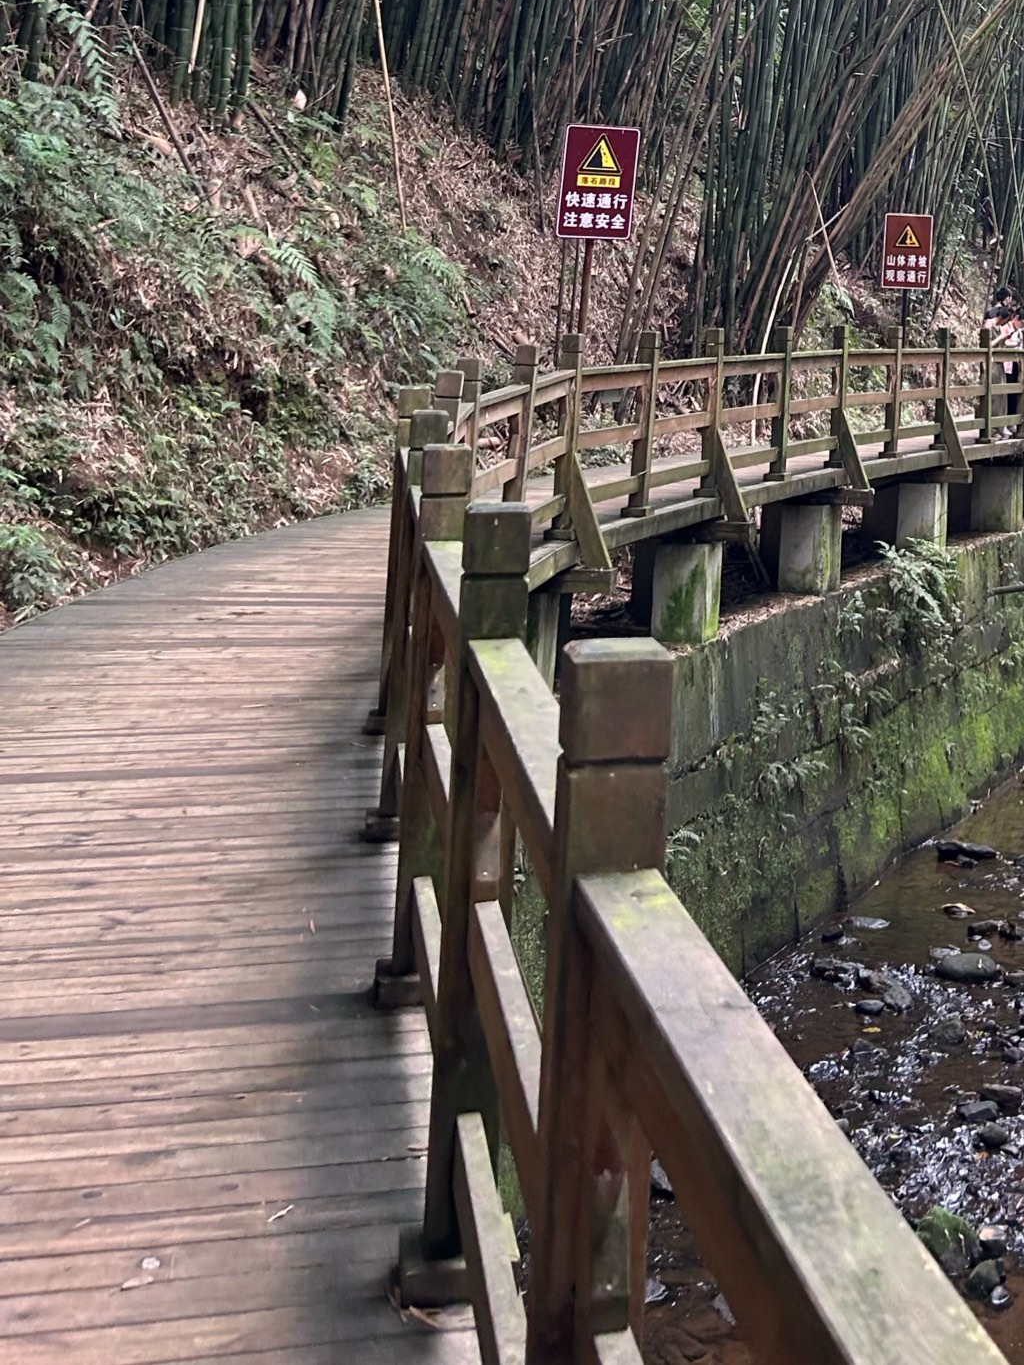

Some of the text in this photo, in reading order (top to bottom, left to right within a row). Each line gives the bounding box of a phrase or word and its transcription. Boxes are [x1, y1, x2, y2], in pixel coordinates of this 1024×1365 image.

[581, 176, 616, 185] 落石路段
[565, 191, 628, 209] 快速通行
[563, 212, 625, 229] 注意安全
[886, 254, 927, 268] 山体滑坡
[885, 269, 927, 283] 观察通行
